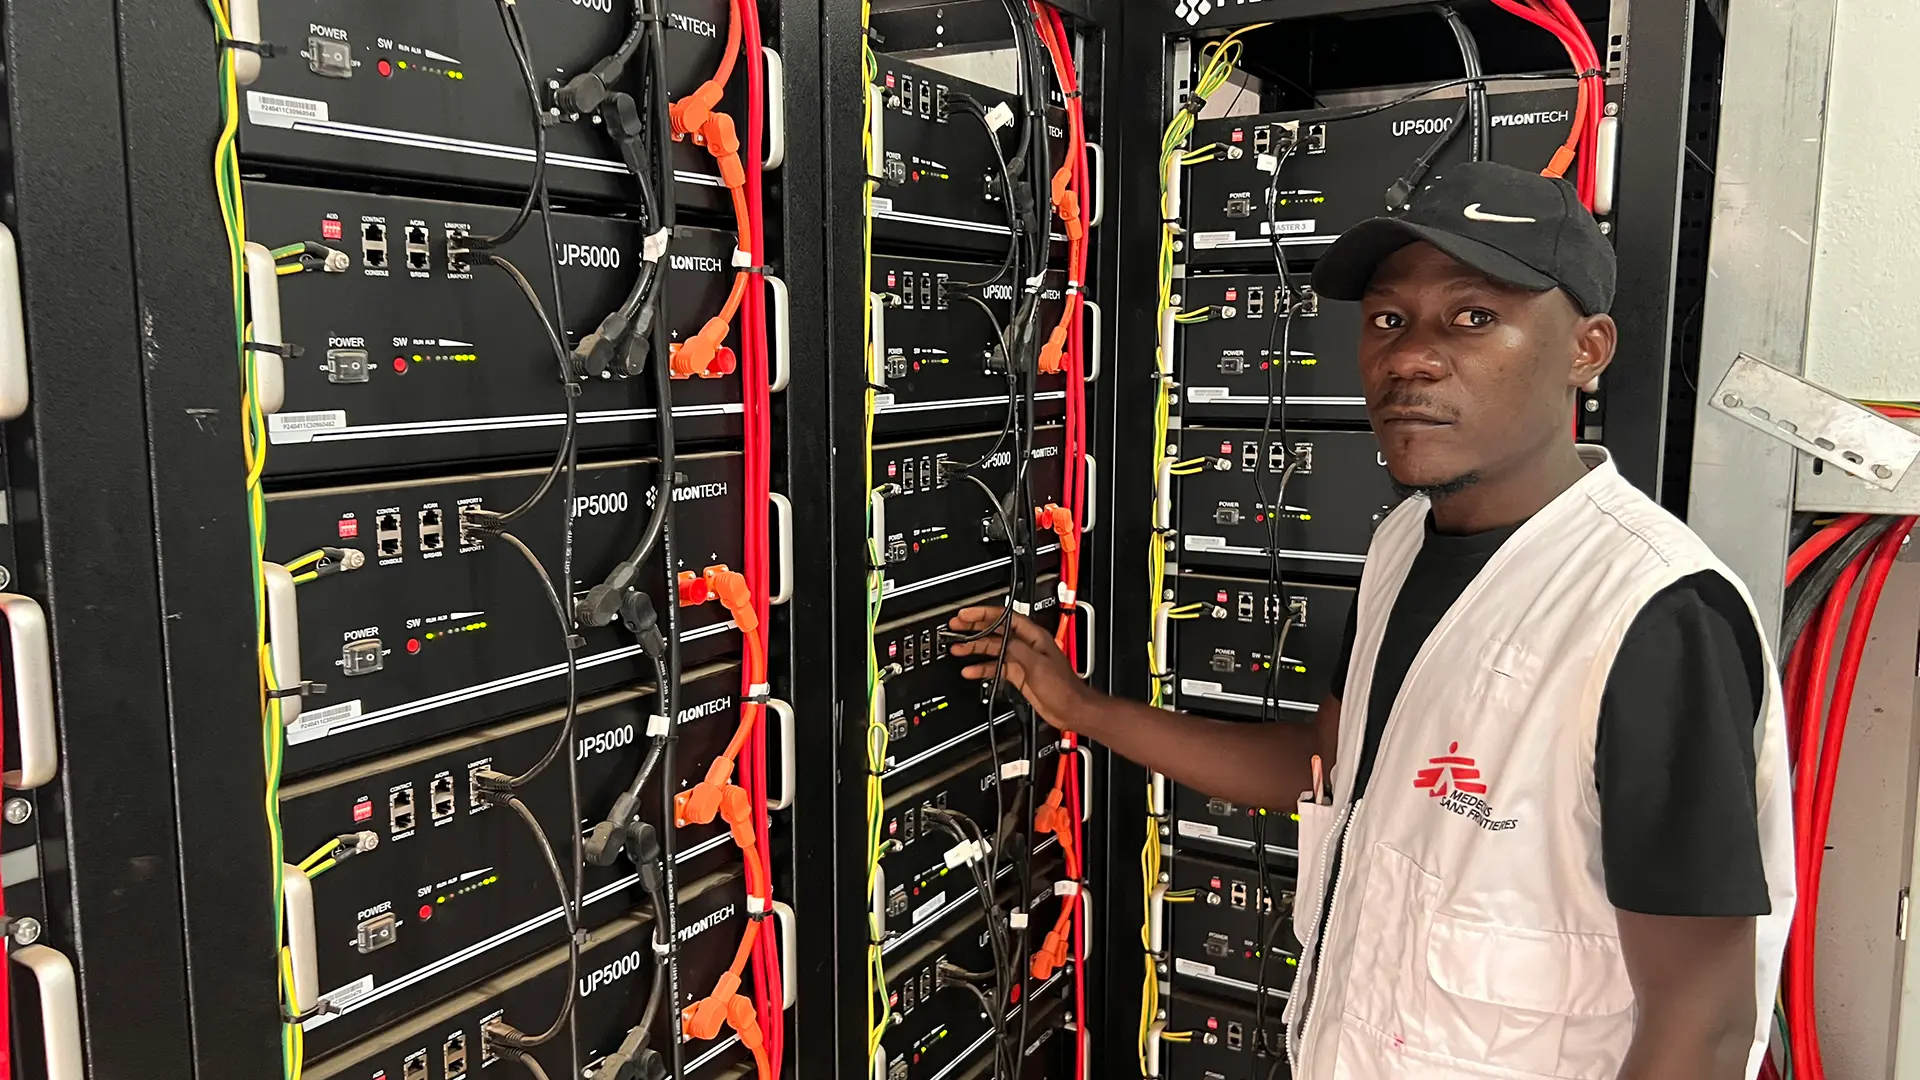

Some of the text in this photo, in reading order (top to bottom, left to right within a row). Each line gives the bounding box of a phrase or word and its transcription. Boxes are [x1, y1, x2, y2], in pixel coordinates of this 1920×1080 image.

[310, 23, 348, 41] POWER
[377, 37, 393, 50] SW
[1491, 110, 1569, 127] PYLONTECH
[886, 151, 902, 160] POWER
[361, 215, 386, 223] CONTACT
[670, 255, 722, 272] LONTECH
[364, 269, 389, 277] CONSOLE
[328, 337, 365, 347] POWER
[393, 337, 408, 347] SW
[672, 482, 727, 502] YLONTECH
[376, 507, 400, 515] CONTACT
[888, 533, 903, 542] POWER
[379, 557, 403, 566] CONSOLE
[406, 618, 421, 629] SW
[344, 626, 379, 641] POWER
[1215, 648, 1235, 656] POWER
[889, 709, 904, 720] POWER
[390, 782, 412, 793] CONTACT
[1440, 796, 1467, 815] SANS
[392, 830, 415, 842] CONSOLE
[418, 884, 433, 898] SW
[357, 901, 392, 921] POWER
[678, 903, 735, 942] YLONTECH
[579, 950, 640, 997] UP5000
[404, 1047, 427, 1062] CONTACT
